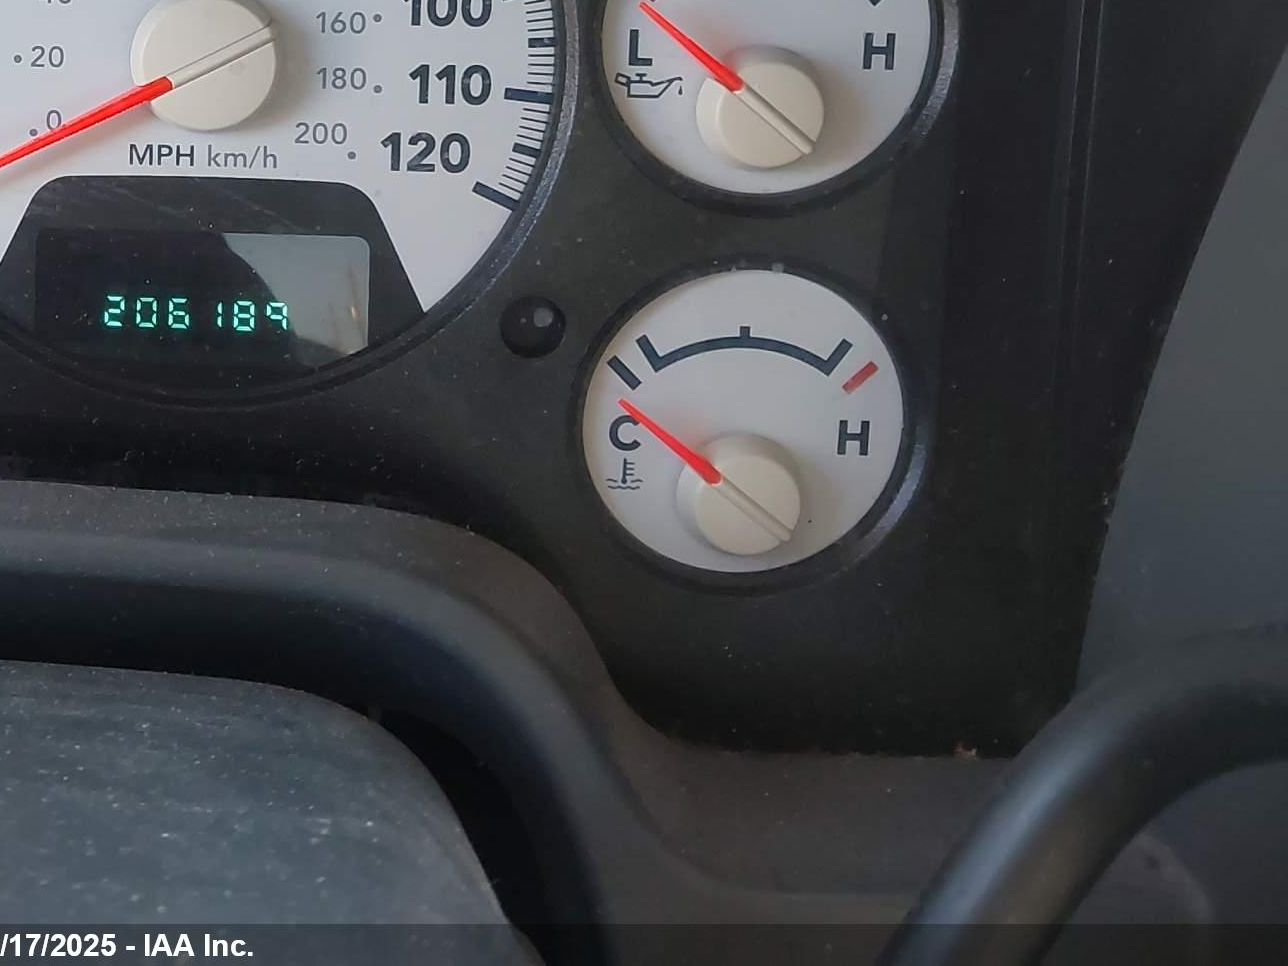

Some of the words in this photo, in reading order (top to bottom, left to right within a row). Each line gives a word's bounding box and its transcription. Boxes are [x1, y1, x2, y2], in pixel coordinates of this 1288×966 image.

[316, 12, 366, 34] 160
[31, 46, 64, 68] 20
[628, 28, 653, 66] L
[863, 33, 896, 71] H
[317, 67, 366, 90] 180
[409, 65, 492, 105] 110
[294, 122, 348, 145] 200
[129, 144, 195, 167] MPH
[207, 144, 278, 170] km/h
[381, 132, 470, 173] 120
[103, 295, 288, 332] 206189
[609, 415, 641, 451] C
[836, 419, 870, 456] H
